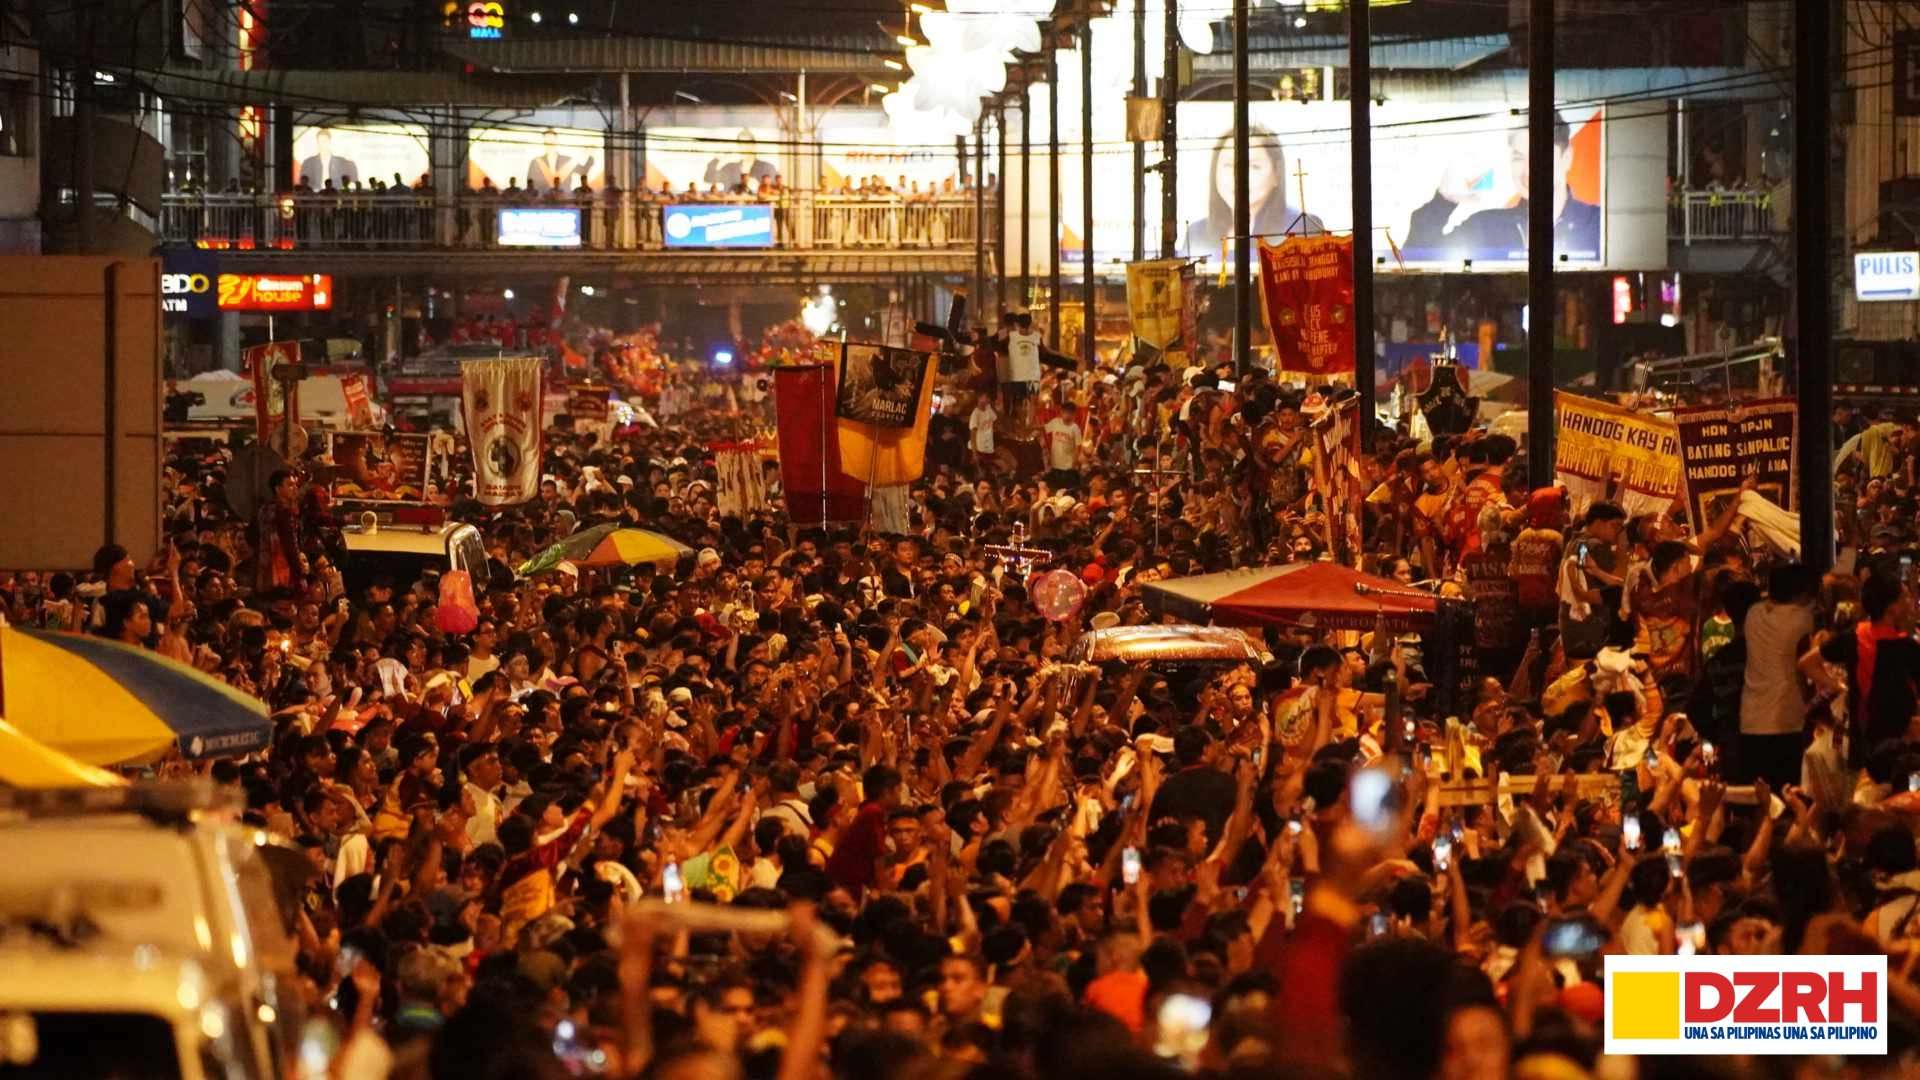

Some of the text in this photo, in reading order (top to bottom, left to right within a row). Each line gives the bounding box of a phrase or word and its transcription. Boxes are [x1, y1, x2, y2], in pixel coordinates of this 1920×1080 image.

[1860, 256, 1913, 275] PULIS
[162, 274, 209, 293] BDO
[254, 289, 302, 302] house
[162, 299, 188, 311] ATM
[1563, 409, 1624, 441] HANDOG
[1627, 427, 1658, 451] KAY
[1687, 443, 1731, 460] BATANG
[1688, 465, 1736, 480] HANDOG
